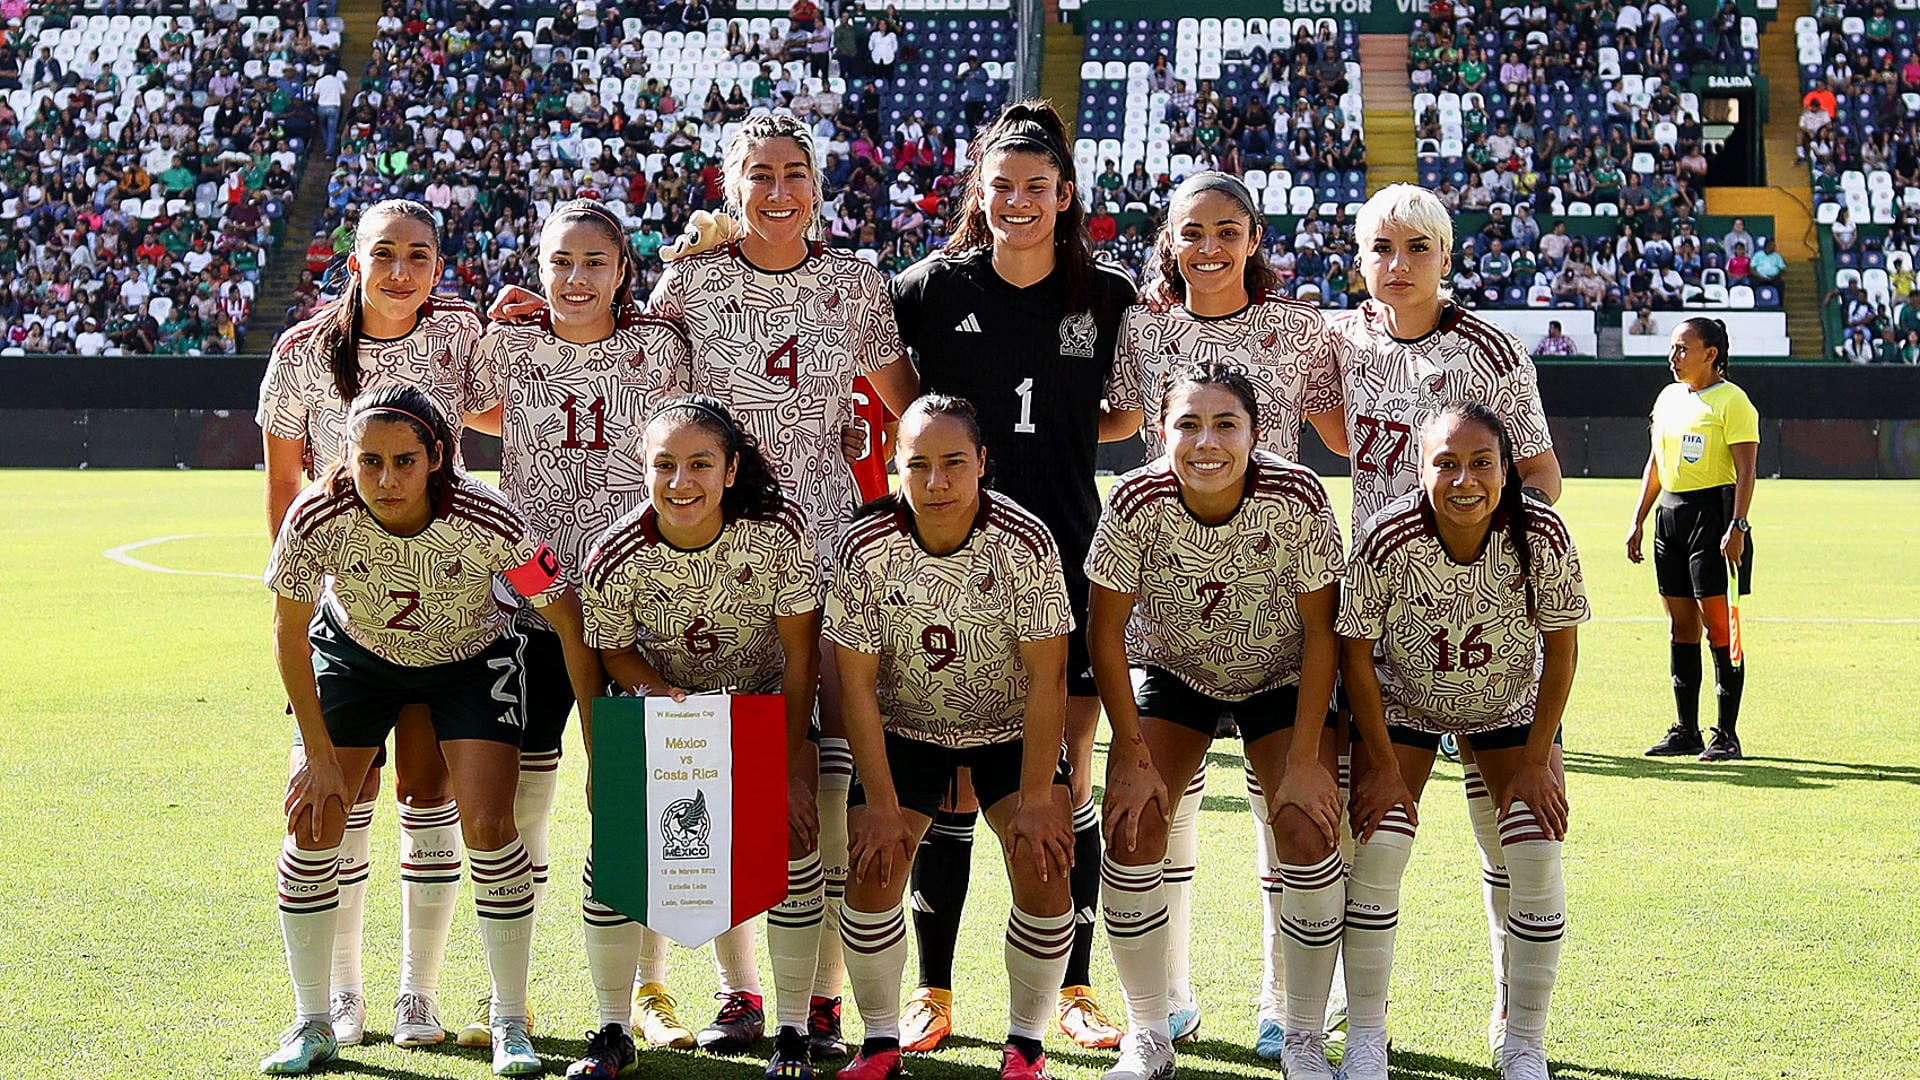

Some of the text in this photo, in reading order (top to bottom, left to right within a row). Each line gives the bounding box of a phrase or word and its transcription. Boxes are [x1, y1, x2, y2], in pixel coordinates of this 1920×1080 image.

[1283, 0, 1371, 13] SECTOR
[1708, 75, 1752, 88] SALIDA
[766, 335, 798, 389] 4
[1014, 377, 1036, 433] 1
[559, 394, 610, 450] 11
[1356, 413, 1411, 476] 27
[1682, 434, 1702, 443] FIFA
[386, 590, 421, 632] 2
[1196, 582, 1227, 621] 7
[684, 614, 720, 655] 6
[1431, 623, 1493, 671] 16
[922, 625, 957, 672] 9
[487, 657, 519, 703] 2
[665, 736, 707, 749] México
[680, 755, 693, 765] vs
[654, 768, 718, 780] Costa Rica
[408, 850, 454, 859] MÉXICO
[665, 846, 707, 857] MÉXICO
[488, 882, 530, 896] MÉXICO
[1292, 915, 1338, 928] MÉXICO
